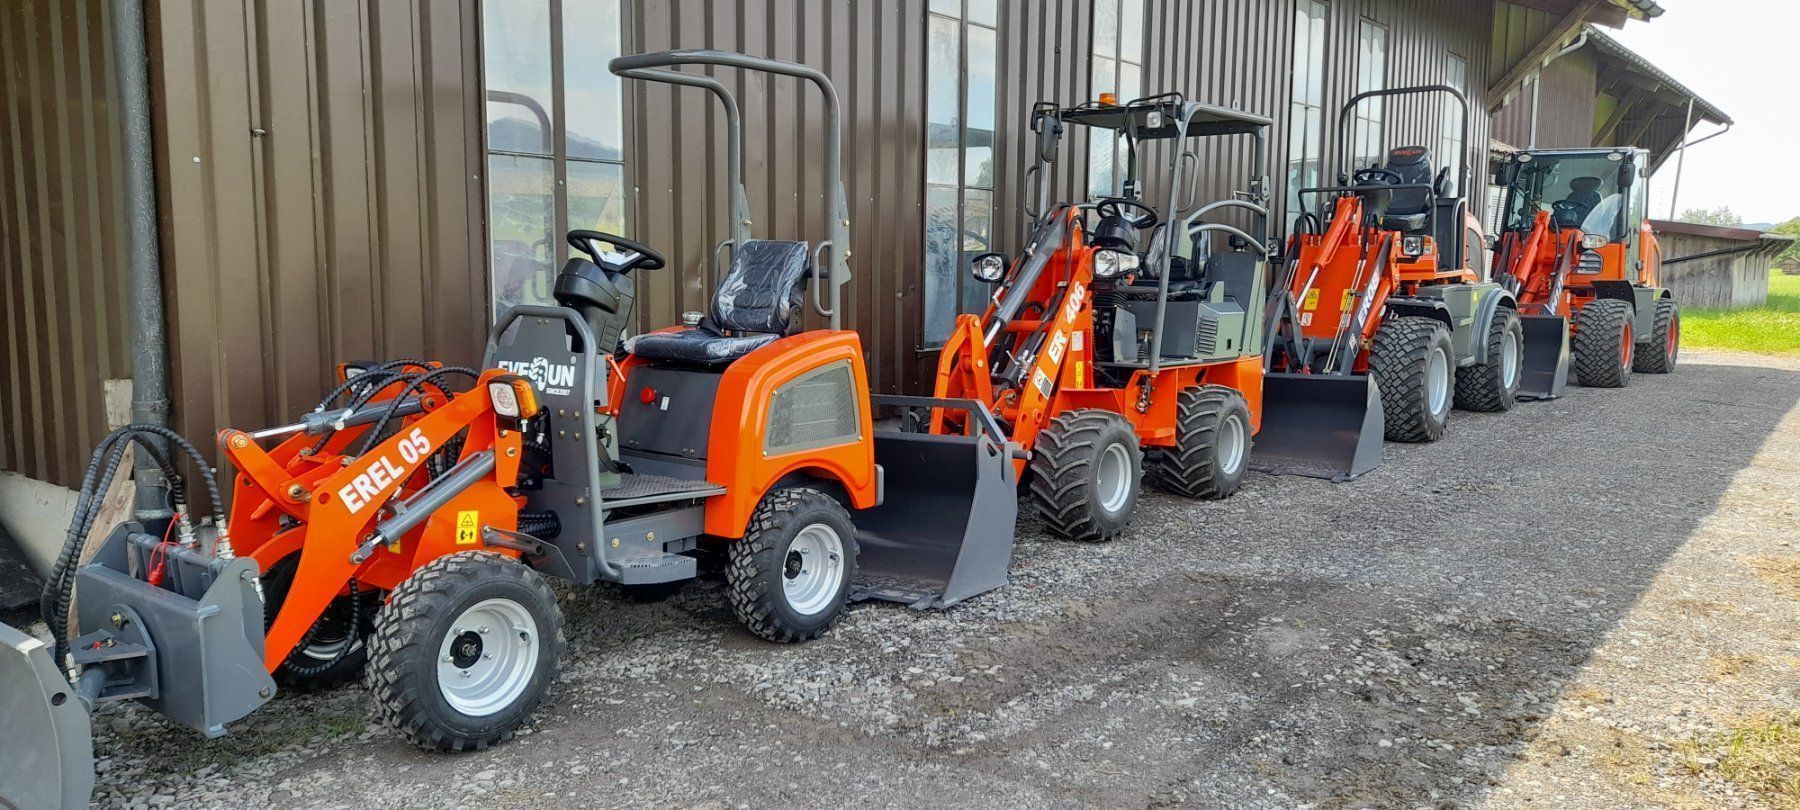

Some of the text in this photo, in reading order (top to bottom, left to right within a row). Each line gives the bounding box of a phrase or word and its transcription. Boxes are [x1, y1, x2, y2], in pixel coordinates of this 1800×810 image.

[1047, 329, 1068, 365] ER
[1065, 281, 1086, 325] 406
[338, 427, 431, 515] EREL 05
